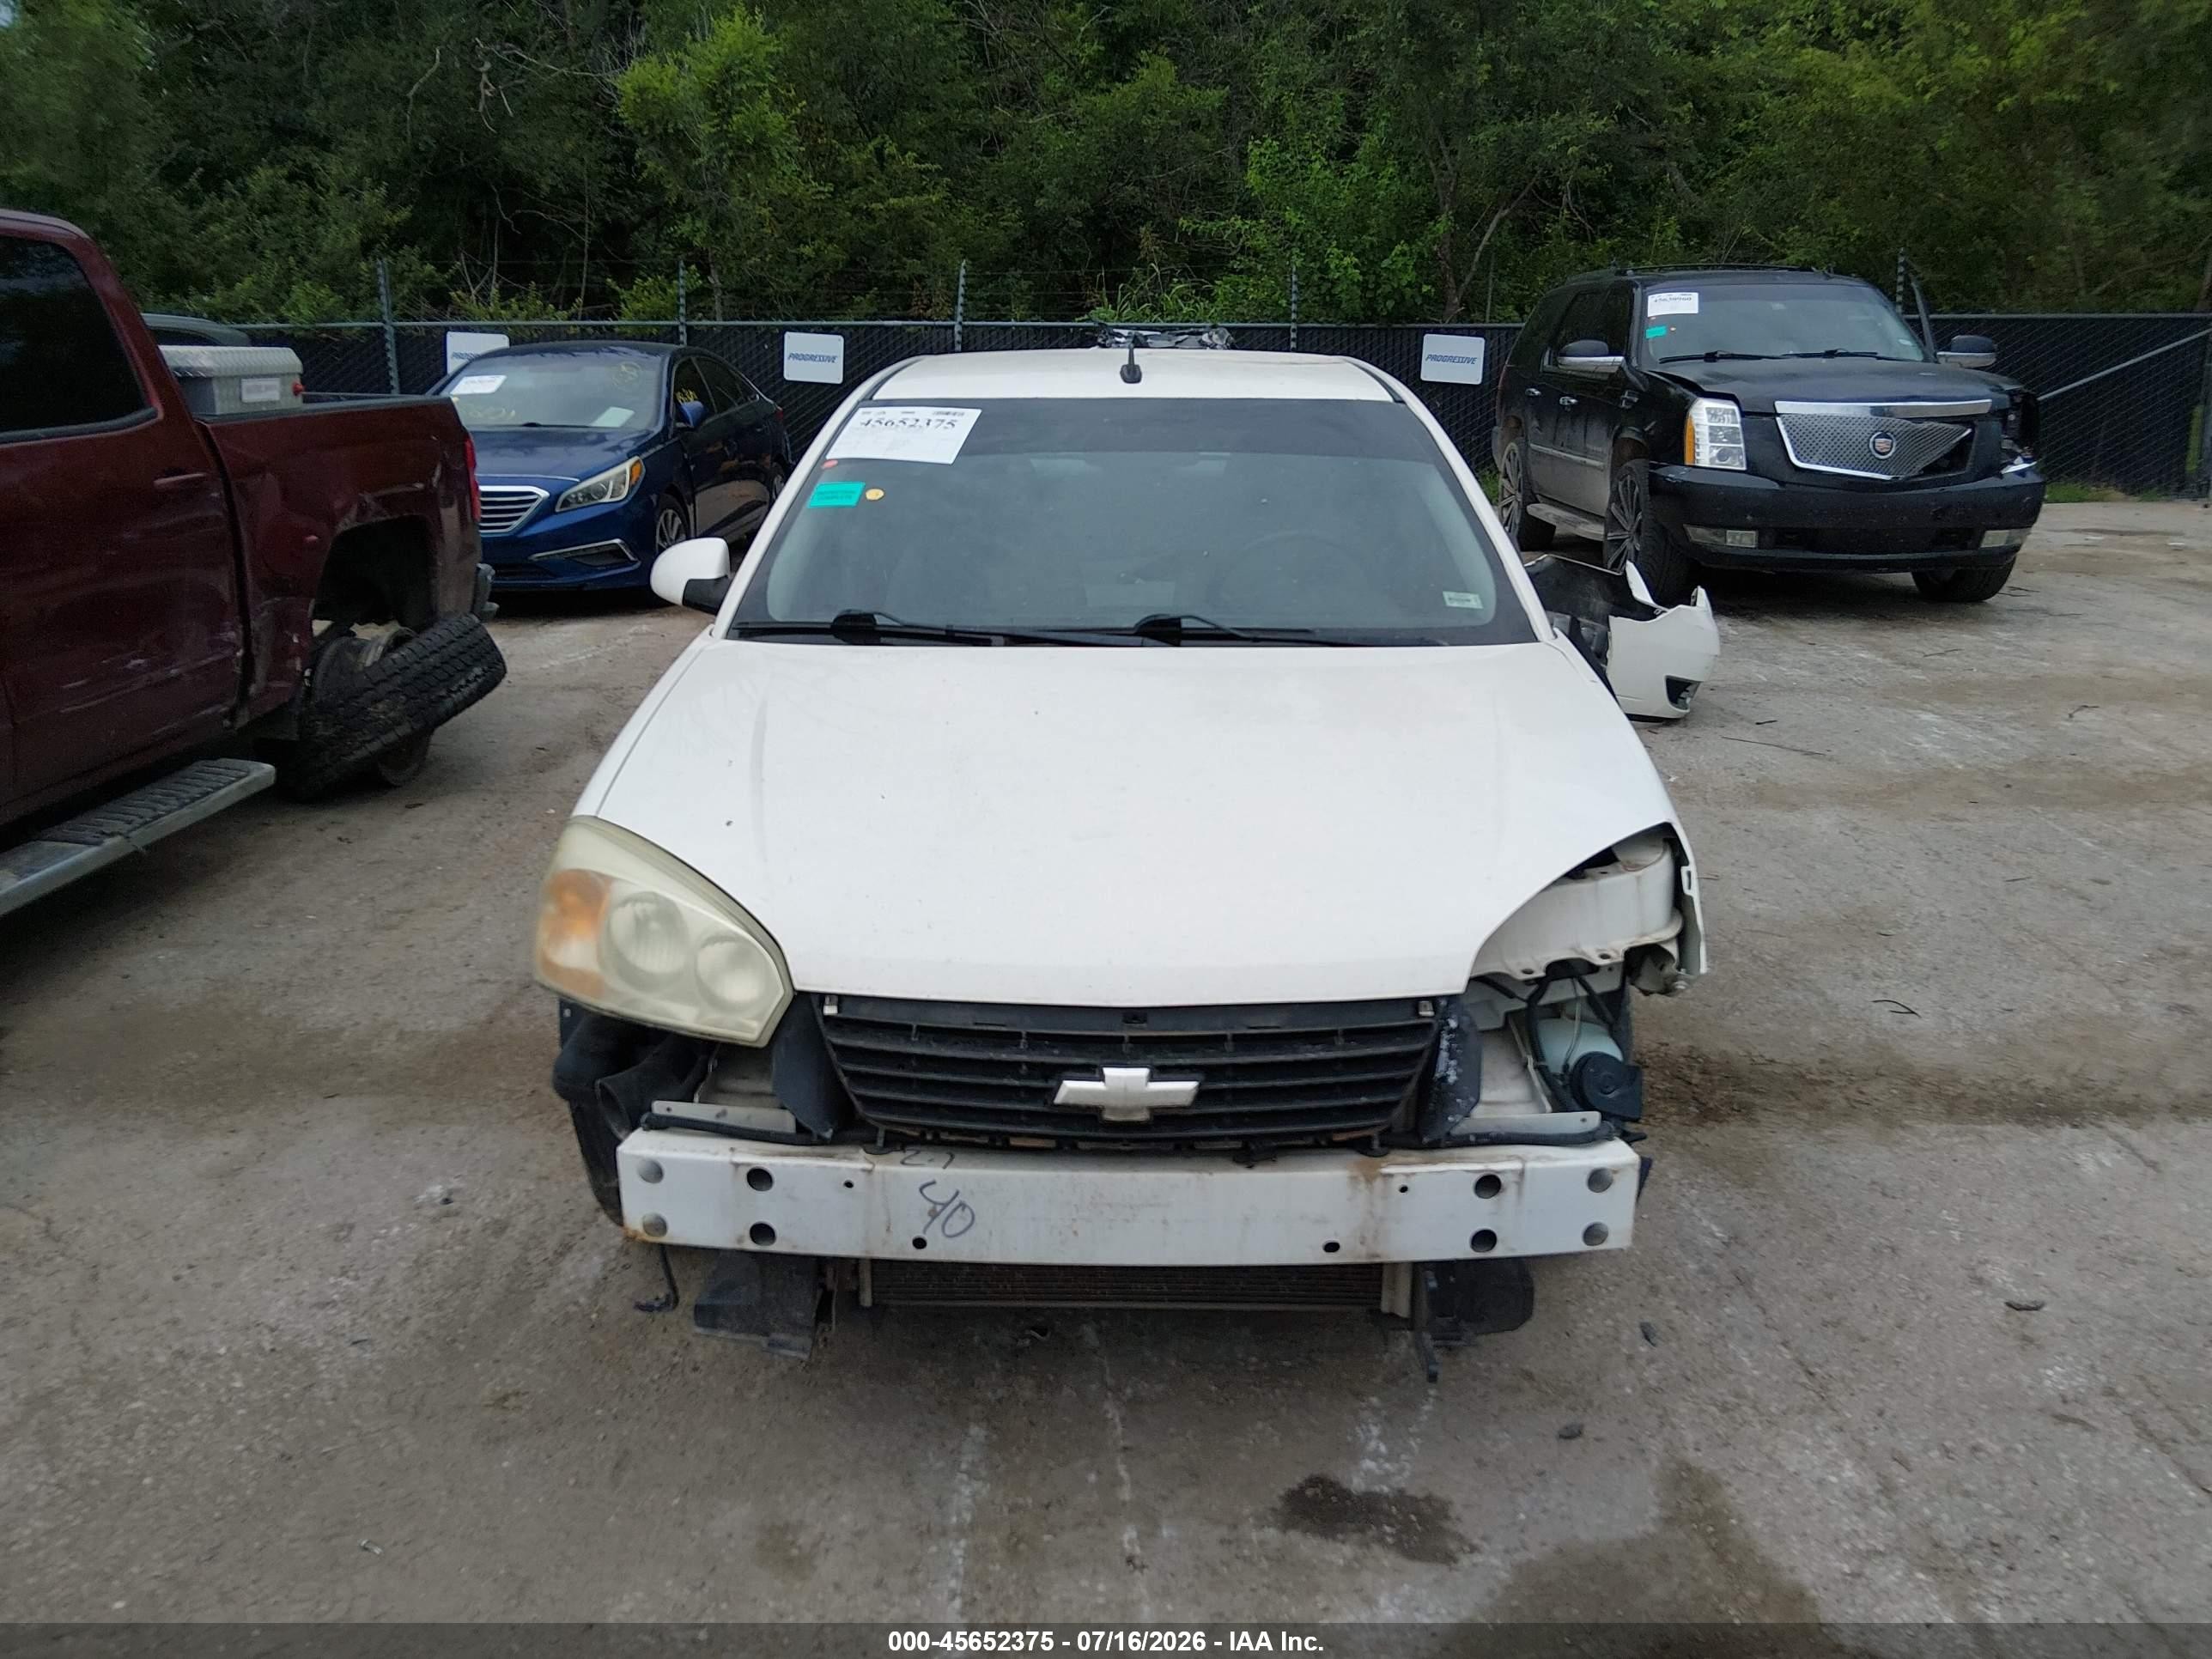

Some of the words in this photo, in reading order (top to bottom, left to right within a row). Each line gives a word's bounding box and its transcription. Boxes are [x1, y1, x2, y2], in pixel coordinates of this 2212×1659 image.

[787, 352, 838, 363] PROGRESSIVE
[1425, 354, 1478, 365] PROGRESSIVE
[860, 417, 958, 430] 45652375
